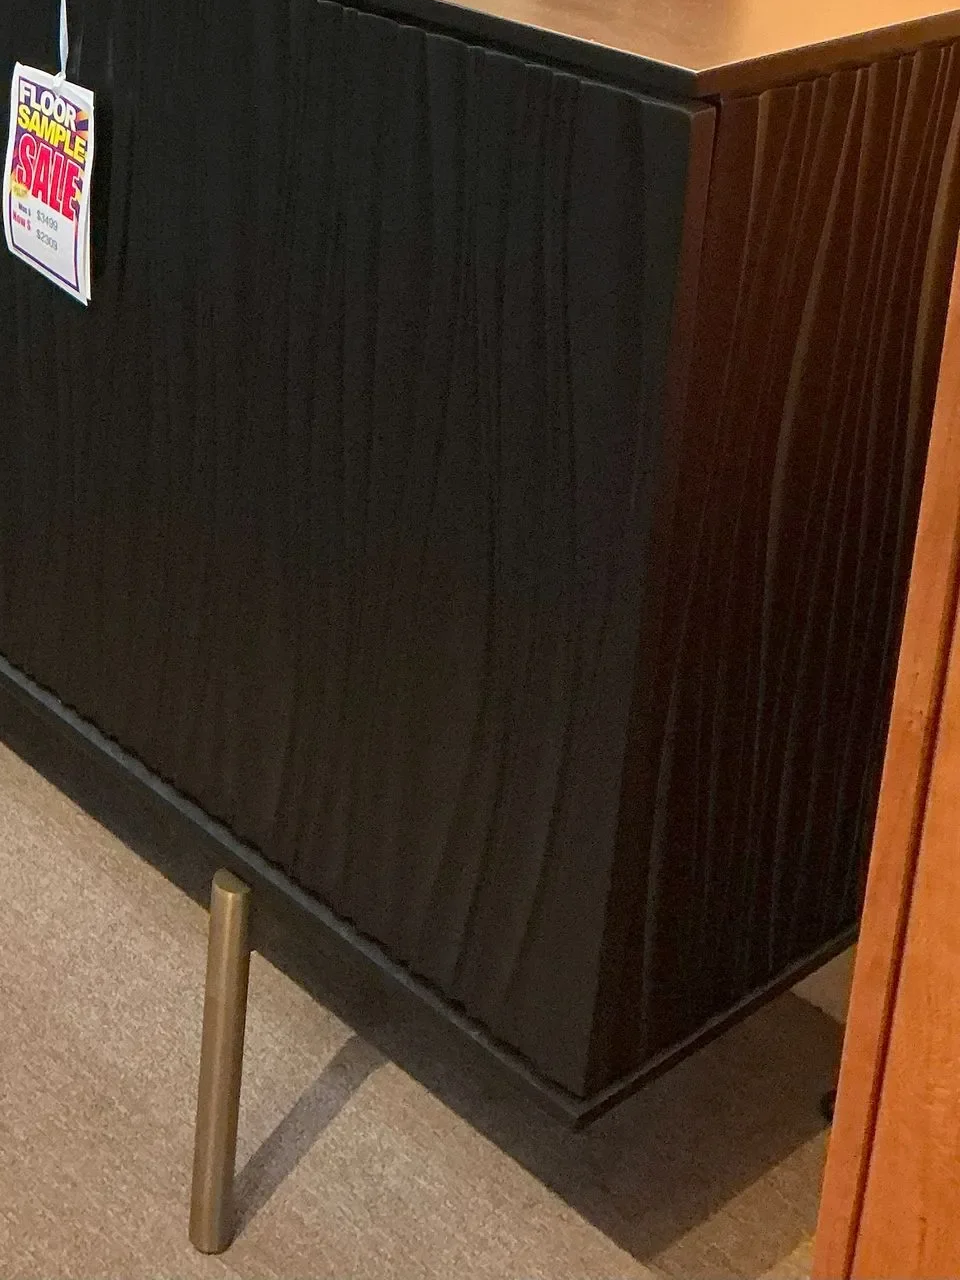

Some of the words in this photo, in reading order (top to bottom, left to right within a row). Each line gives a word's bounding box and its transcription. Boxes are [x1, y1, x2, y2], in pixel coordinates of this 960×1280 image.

[18, 104, 86, 164] SAMPLE
[19, 79, 77, 132] FLOOR
[16, 133, 81, 221] SALE
